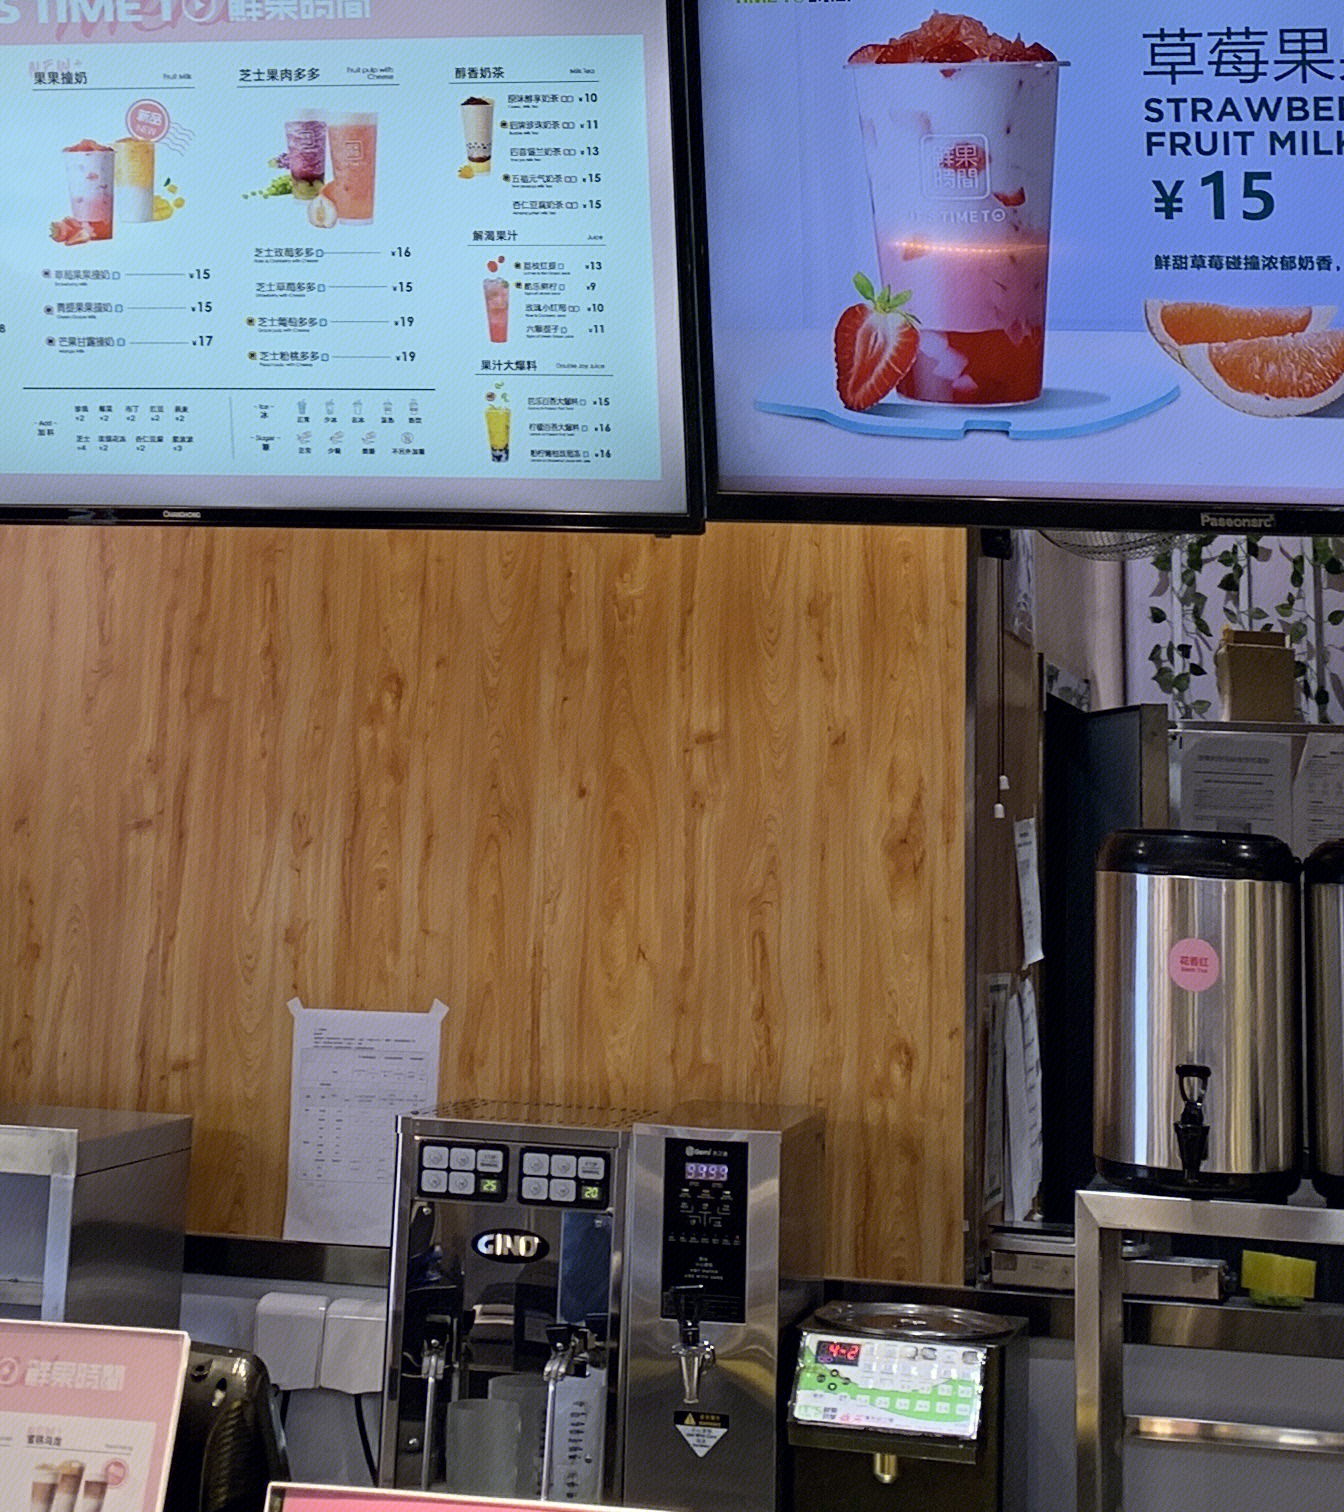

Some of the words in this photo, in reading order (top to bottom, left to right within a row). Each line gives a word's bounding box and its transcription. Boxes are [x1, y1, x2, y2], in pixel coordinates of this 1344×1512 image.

[33, 71, 88, 86] 果果撞奶
[238, 67, 321, 83] 芝士果肉多多
[454, 66, 505, 80] 醇香奶茶
[1146, 130, 1255, 157] FRUIT
[472, 229, 518, 242] 解渴果汁
[480, 359, 538, 372] 果汁大爆料
[482, 1179, 497, 1193] 25
[583, 1186, 599, 1199] 20
[476, 1232, 541, 1258] GINO
